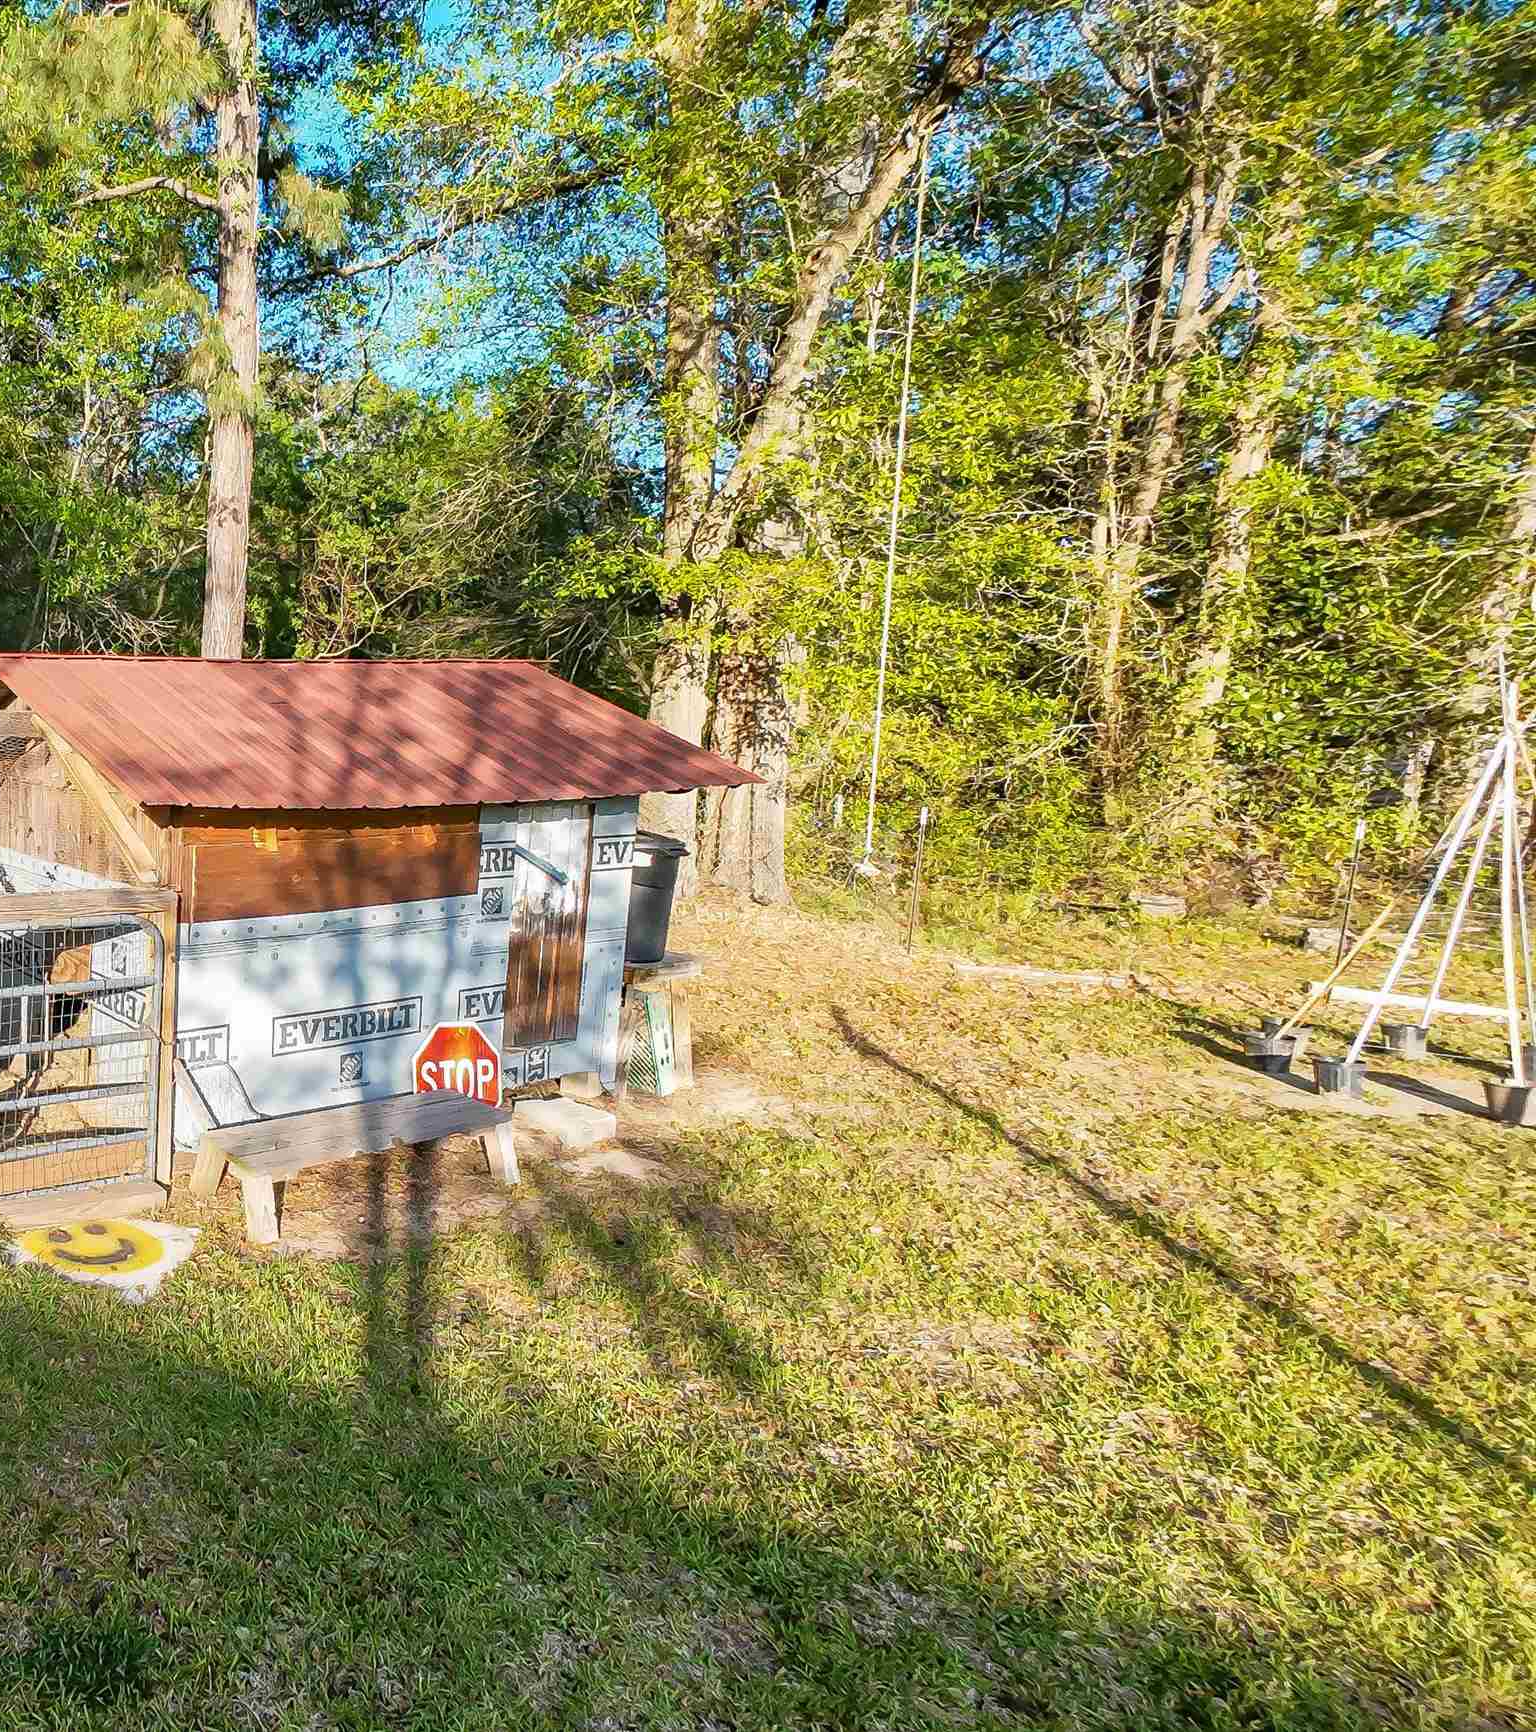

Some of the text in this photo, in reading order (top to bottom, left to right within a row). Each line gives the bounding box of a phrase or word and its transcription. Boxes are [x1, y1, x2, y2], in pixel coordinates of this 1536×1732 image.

[597, 841, 635, 864] EV
[464, 990, 506, 1019] EV
[279, 1003, 417, 1050] EVERBILT
[421, 1058, 495, 1099] STOP
